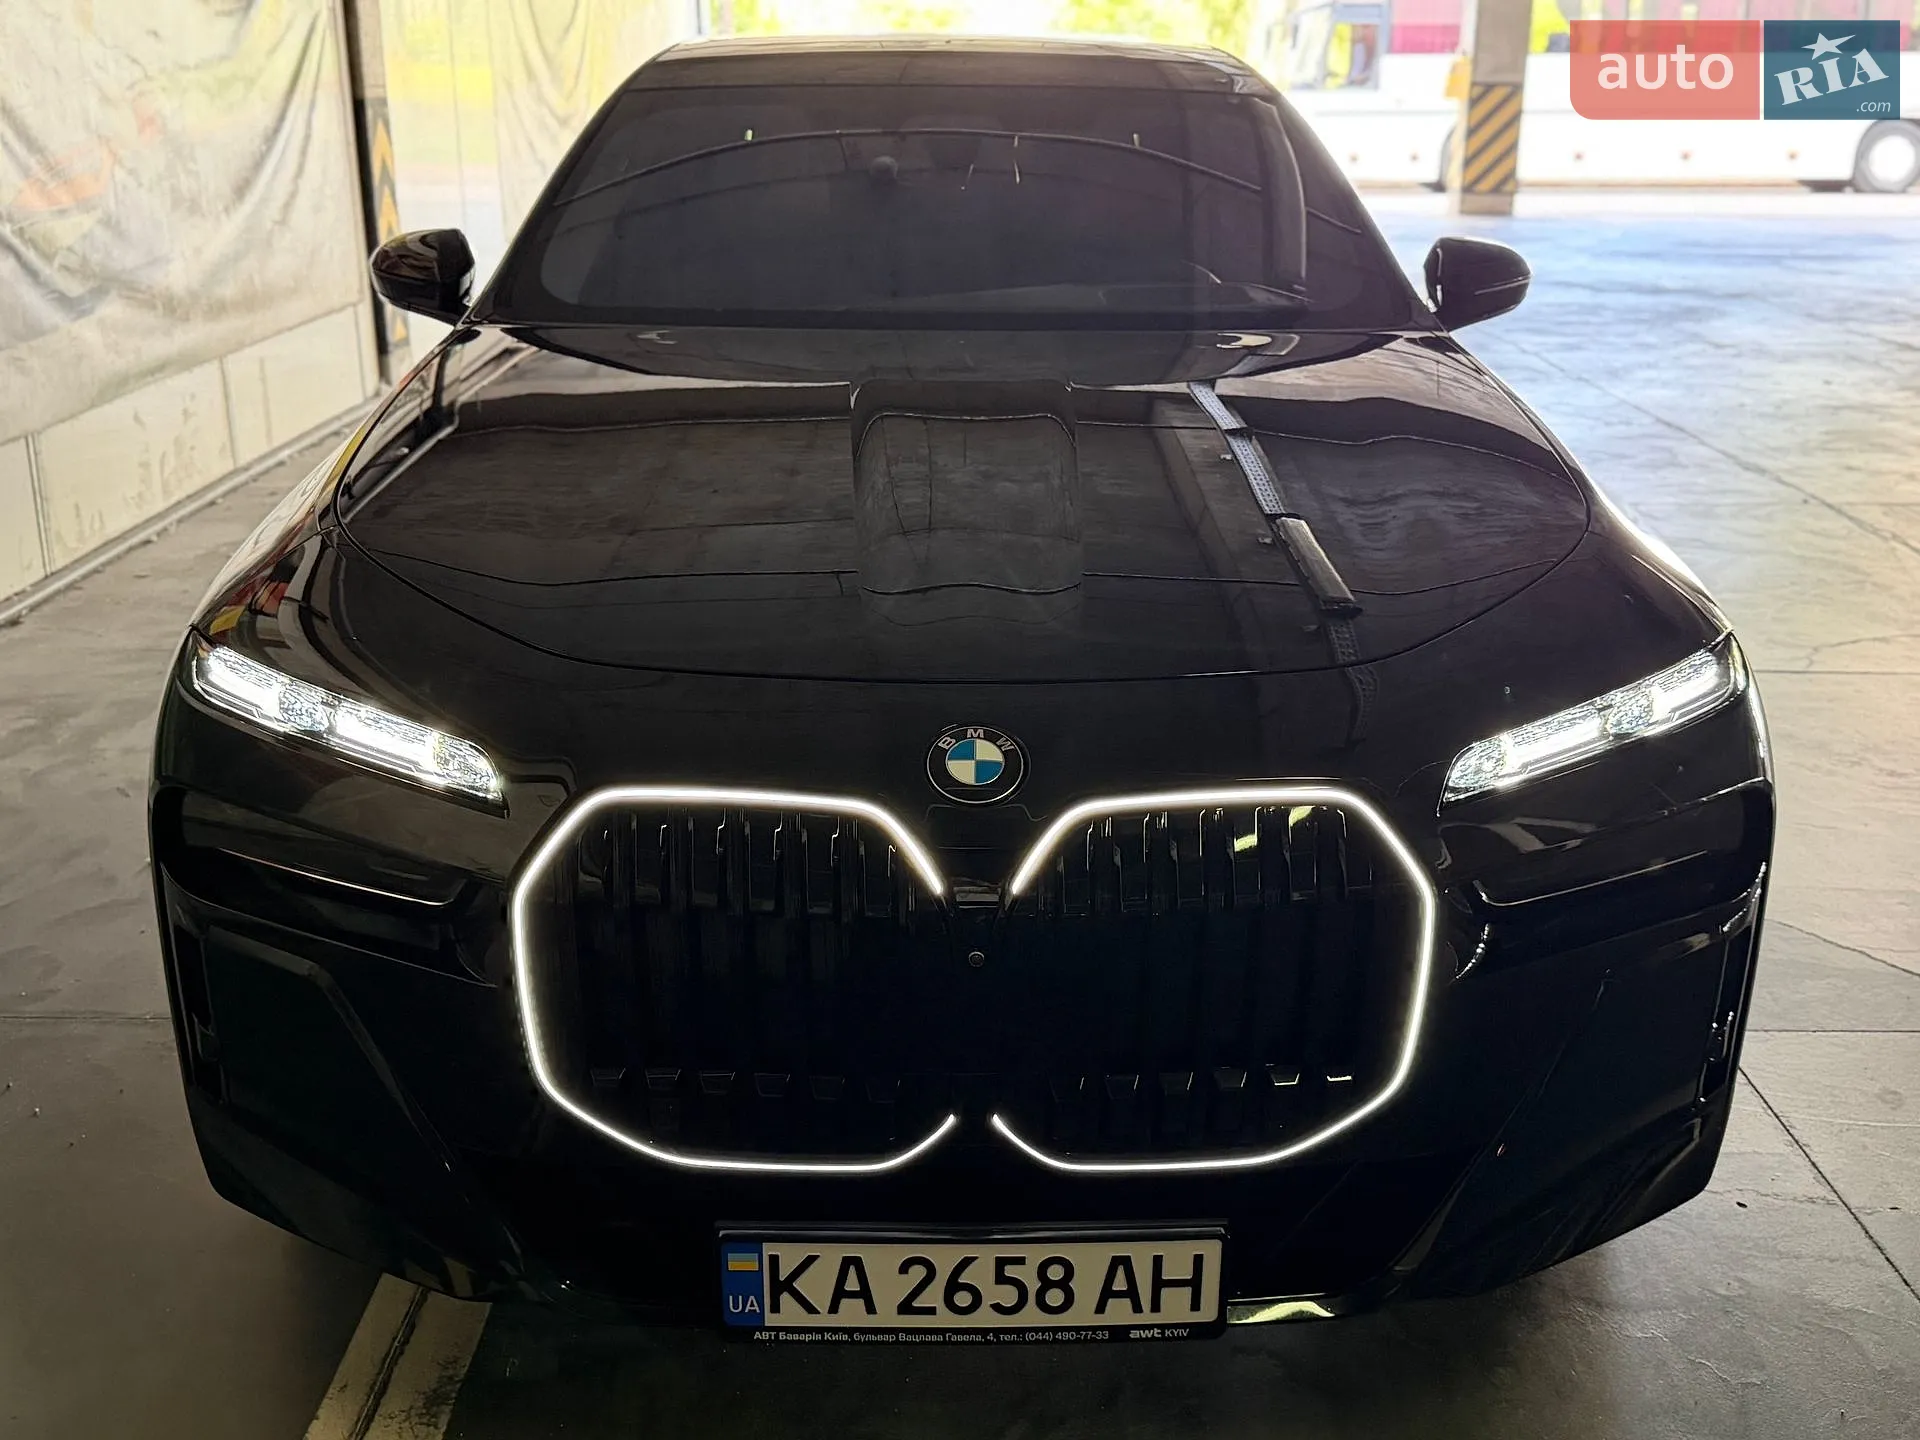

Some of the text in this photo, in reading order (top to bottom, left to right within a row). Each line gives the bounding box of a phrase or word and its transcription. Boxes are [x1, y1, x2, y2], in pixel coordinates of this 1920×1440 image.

[937, 728, 1016, 752] BMW
[767, 1252, 1206, 1316] KA 2658 AH
[729, 1295, 761, 1313] UA
[753, 1331, 777, 1340] АВТ
[778, 1331, 822, 1342] Баварія
[853, 1332, 896, 1342] бульвар
[898, 1332, 943, 1343] Вацлава
[1025, 1331, 1053, 1342] (044)
[1055, 1330, 1109, 1341] 490-77-33
[1129, 1328, 1190, 1339] awt KYIV
